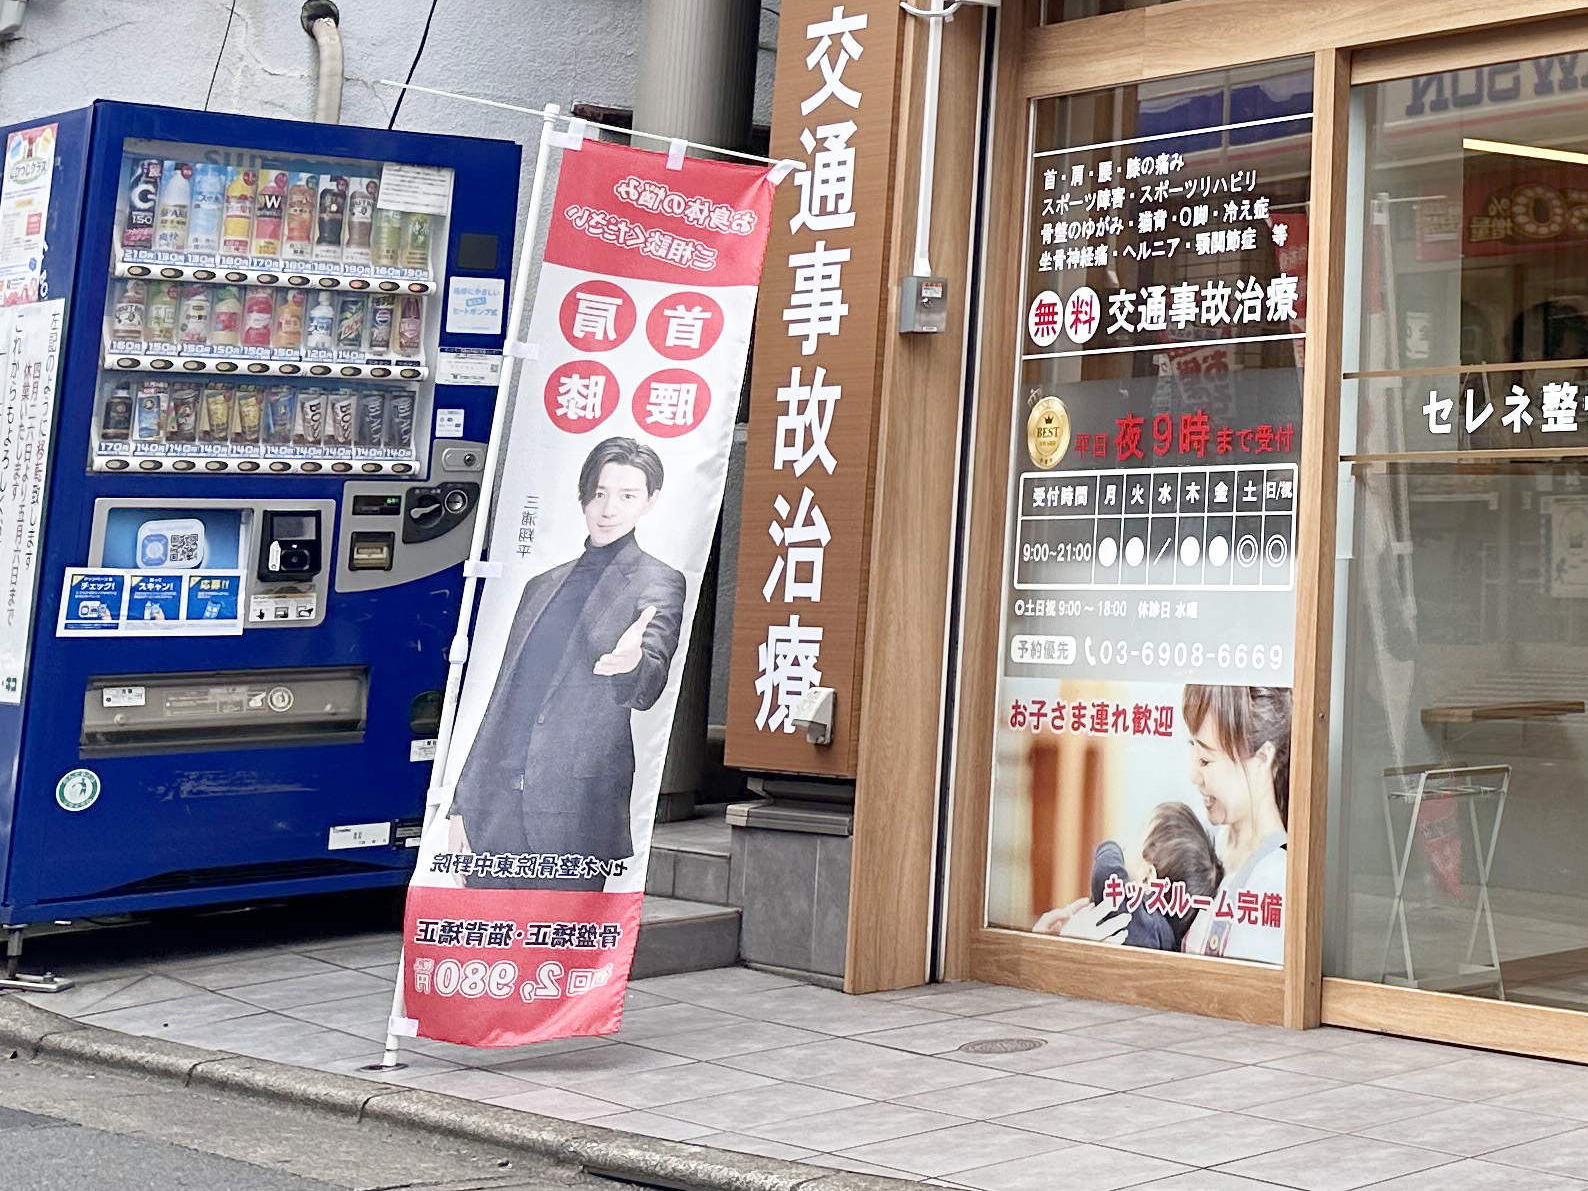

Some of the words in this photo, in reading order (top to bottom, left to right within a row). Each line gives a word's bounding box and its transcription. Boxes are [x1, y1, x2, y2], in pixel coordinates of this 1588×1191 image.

[1043, 153, 1184, 191] 首・肩・腰・膝の痛み
[1034, 294, 1096, 338] 無料
[1106, 273, 1299, 335] 交通事故治療
[755, 5, 868, 735] 交通事故治療
[1036, 426, 1060, 439] BEST
[1032, 486, 1088, 507] 受付時間
[1104, 485, 1116, 505] 月
[1131, 484, 1144, 505] 火
[1158, 483, 1172, 504] 水
[1185, 482, 1200, 504] 木
[1214, 481, 1229, 503] 金
[1242, 480, 1257, 502] 土
[1017, 640, 1069, 660] 予約優先
[1100, 640, 1284, 670] 03-6908-6669
[1010, 699, 1174, 737] お子さま連れ歓迎
[1104, 877, 1284, 928] キッズルーム完備
